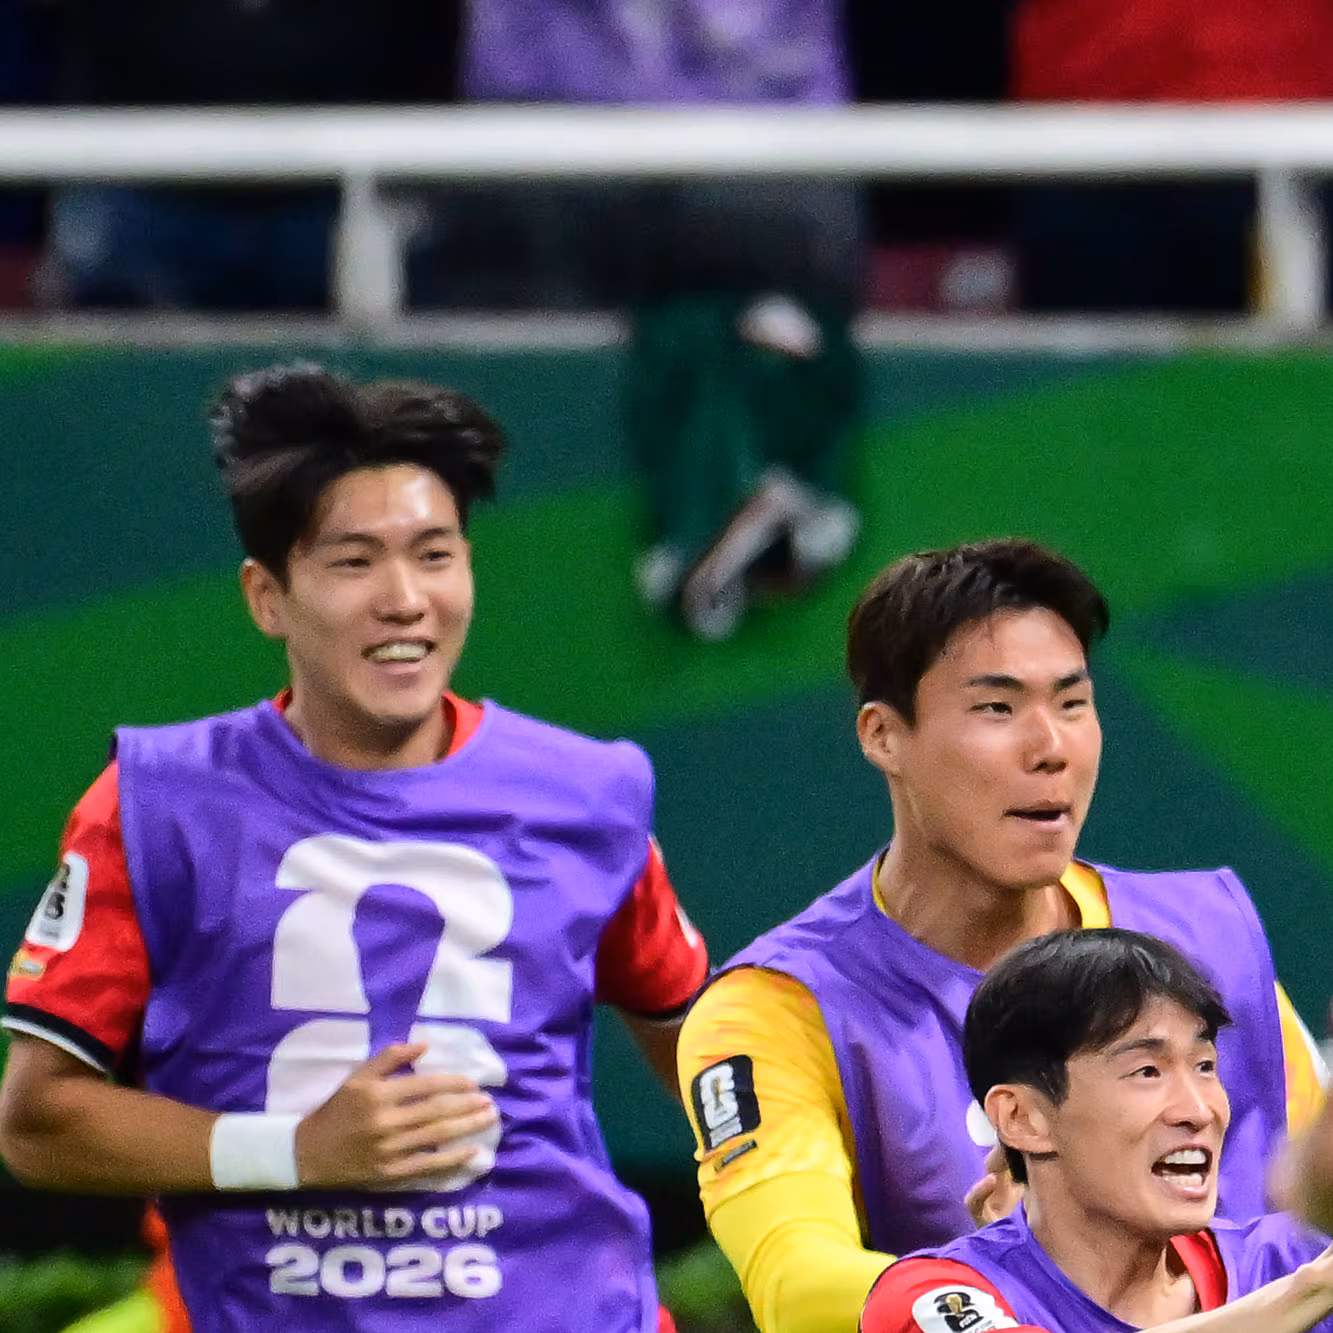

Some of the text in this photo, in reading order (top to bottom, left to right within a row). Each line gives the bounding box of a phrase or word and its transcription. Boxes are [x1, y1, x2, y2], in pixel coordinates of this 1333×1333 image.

[266, 1204, 504, 1239] WORLD CUP
[265, 1243, 502, 1300] 2026
